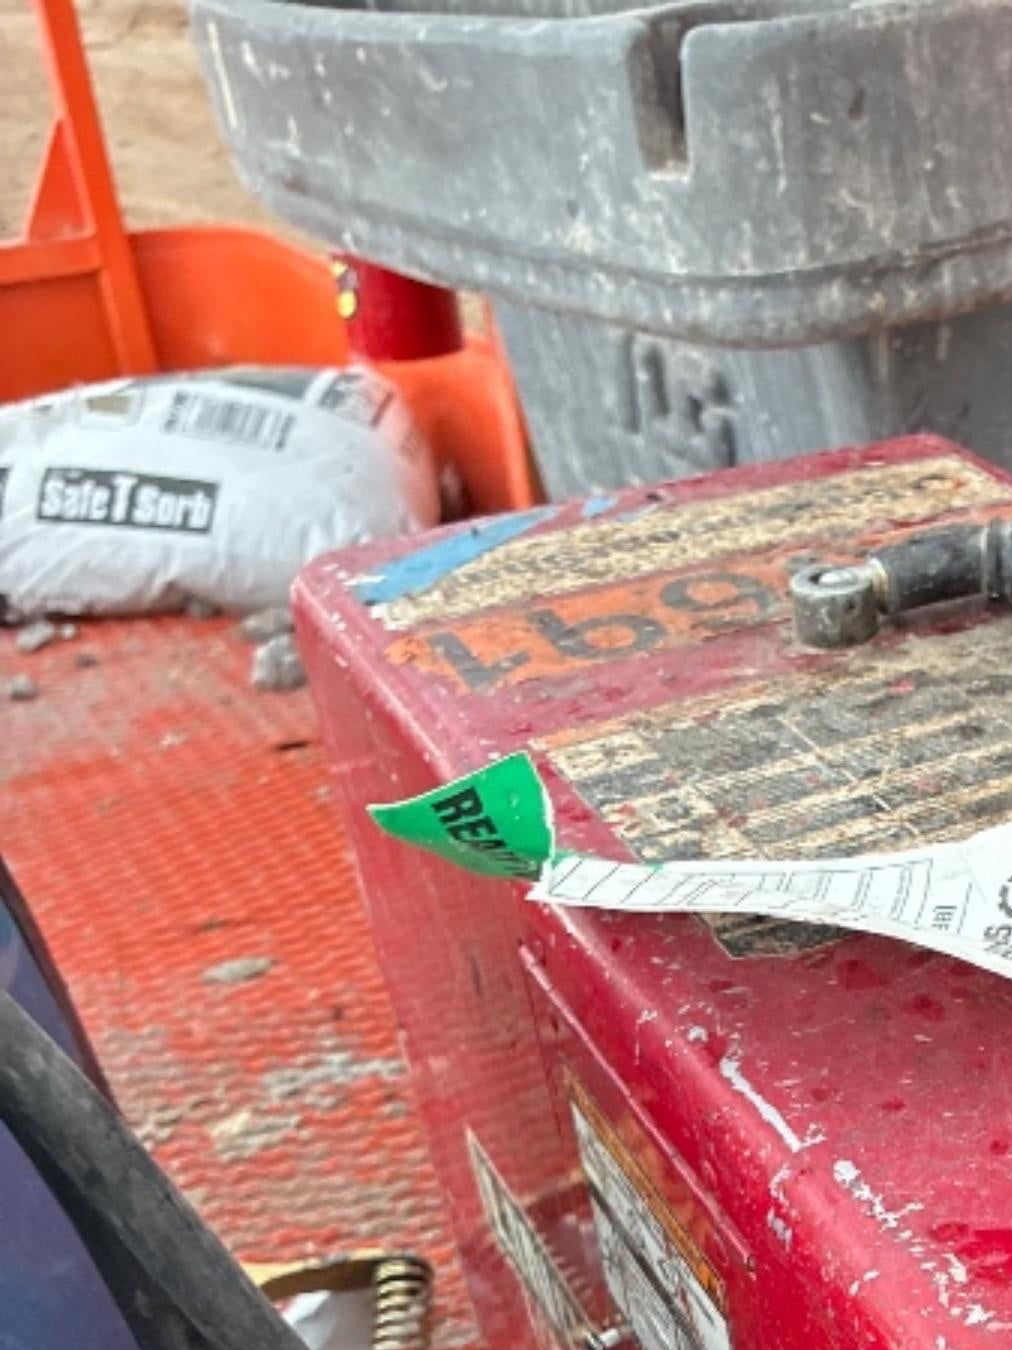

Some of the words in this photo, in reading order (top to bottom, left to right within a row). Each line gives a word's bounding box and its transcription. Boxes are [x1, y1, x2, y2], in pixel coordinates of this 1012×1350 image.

[42, 477, 107, 520] Safe
[111, 474, 137, 523] T
[134, 485, 210, 528] Sorb
